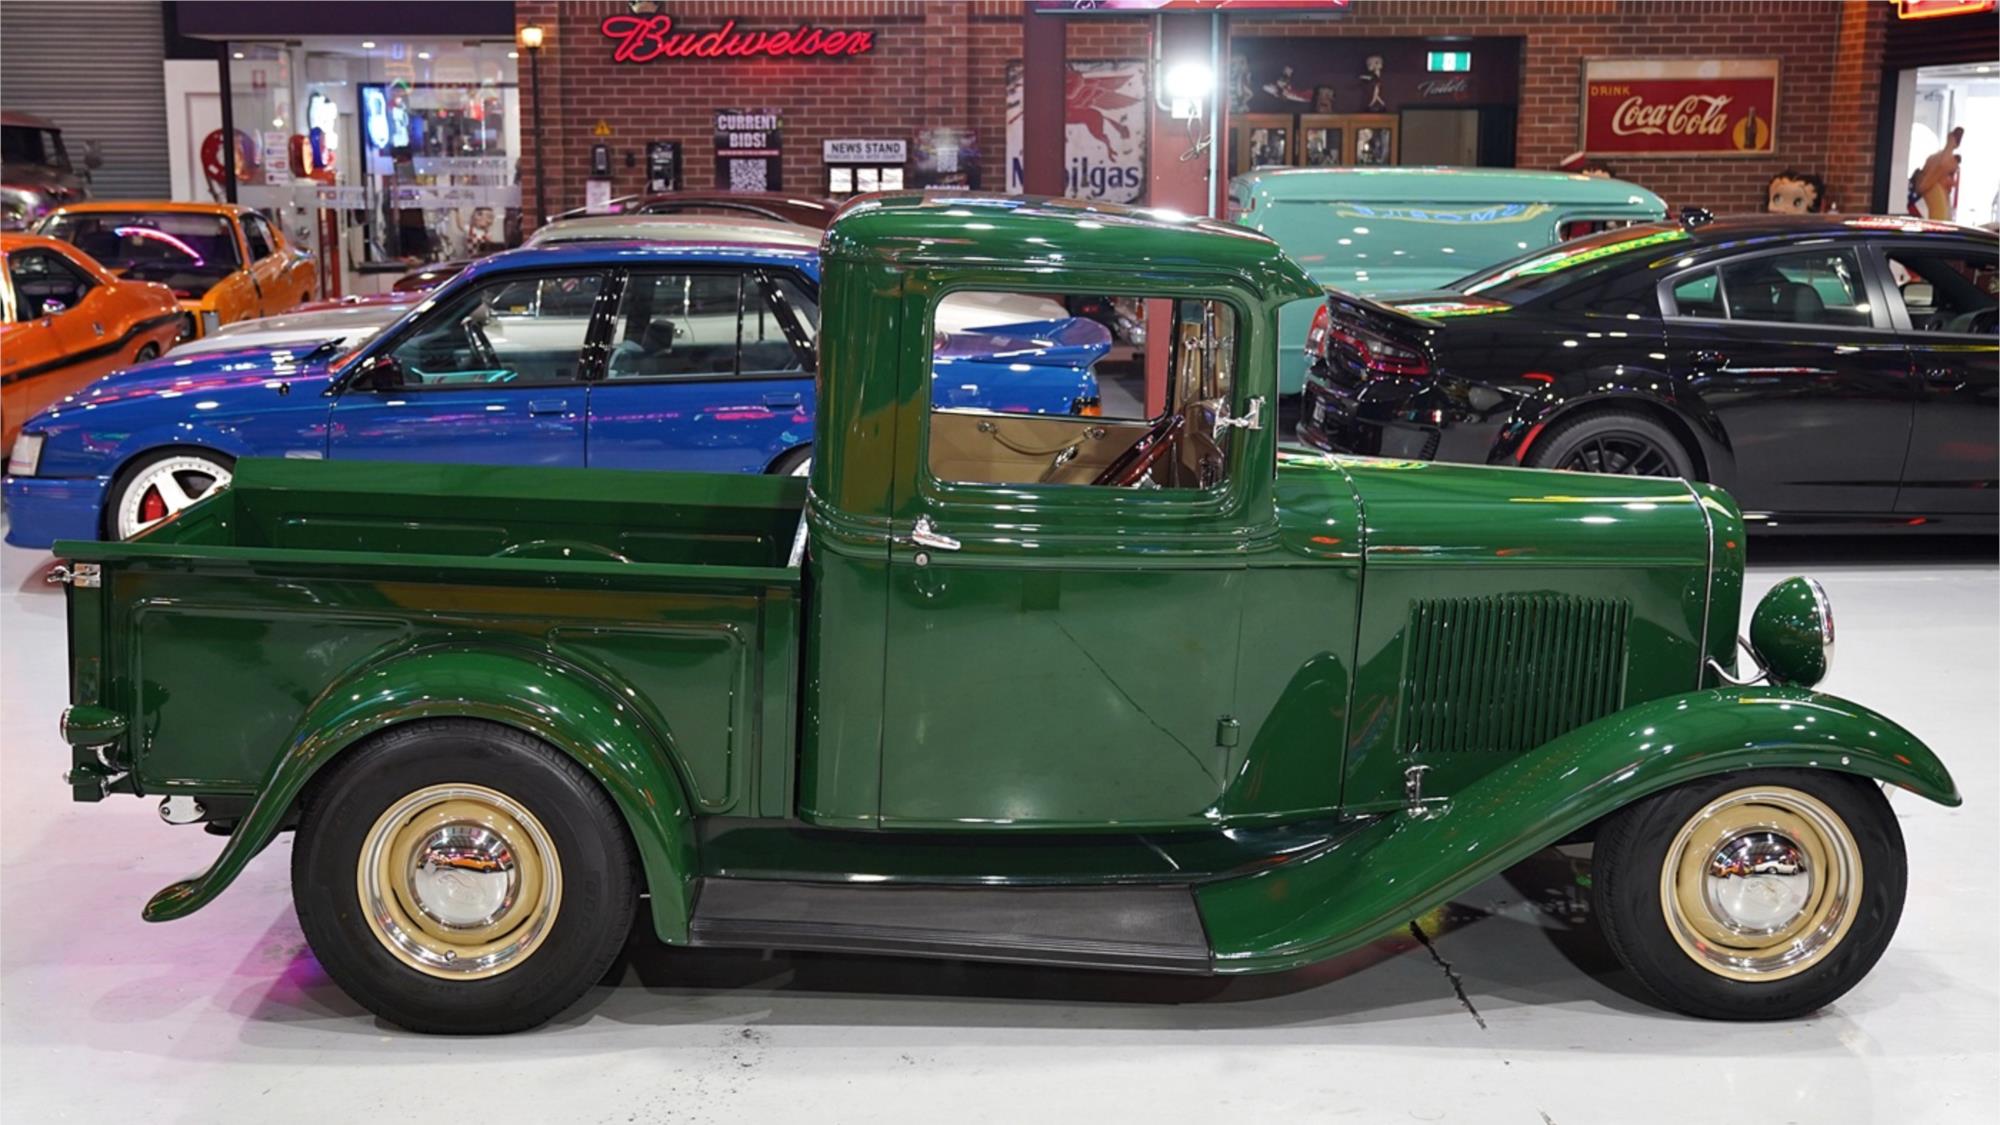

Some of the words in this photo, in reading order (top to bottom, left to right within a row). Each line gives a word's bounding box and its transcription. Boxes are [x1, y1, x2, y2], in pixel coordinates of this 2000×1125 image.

[602, 15, 872, 63] Budweiser
[1590, 86, 1630, 97] DRINK
[718, 114, 777, 130] CURRENT
[1612, 94, 1733, 136] Coca-Cola
[729, 132, 767, 149] BIDS!
[831, 143, 862, 153] NEWS
[865, 143, 901, 153] STAND
[1011, 156, 1139, 198] Milgas
